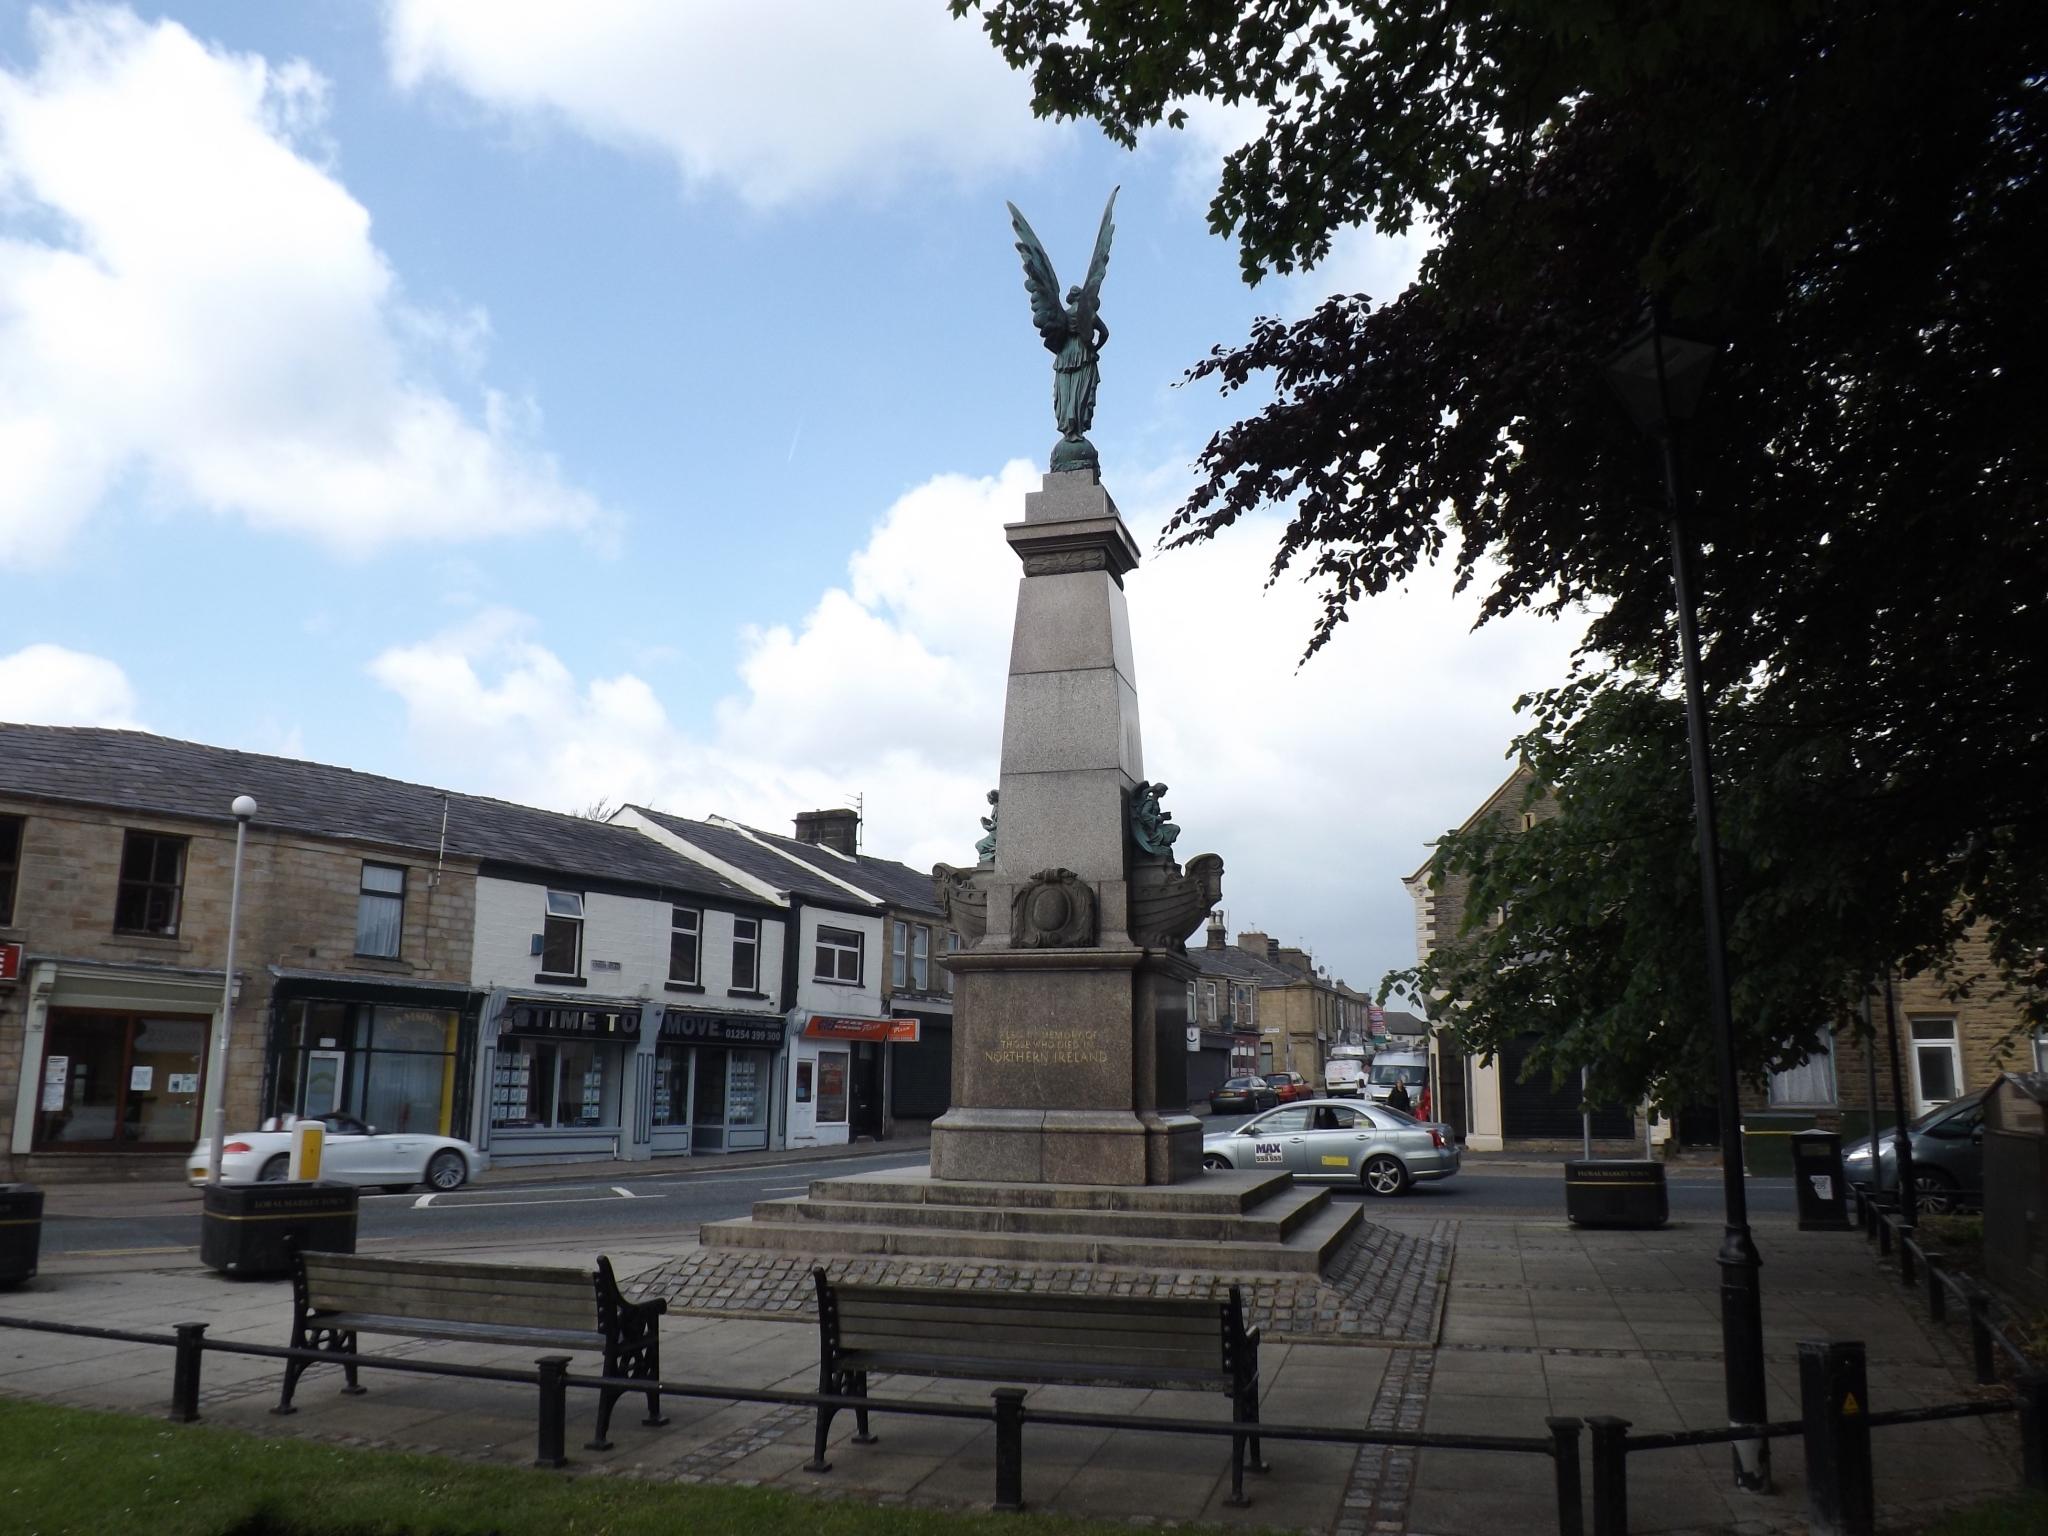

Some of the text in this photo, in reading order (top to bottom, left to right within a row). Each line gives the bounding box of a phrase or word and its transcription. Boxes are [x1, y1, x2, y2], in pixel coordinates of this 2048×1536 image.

[535, 1010, 637, 1033] TIME TO
[664, 1013, 720, 1037] MOVE
[725, 1028, 781, 1041] 01254 399 300
[1085, 1031, 1097, 1039] OF
[1034, 1040, 1055, 1049] WHO
[985, 1051, 1107, 1063] NORTHERN IRELAND
[1255, 1143, 1281, 1154] MAX
[285, 1199, 319, 1207] MARKET
[321, 1198, 346, 1206] TOWN
